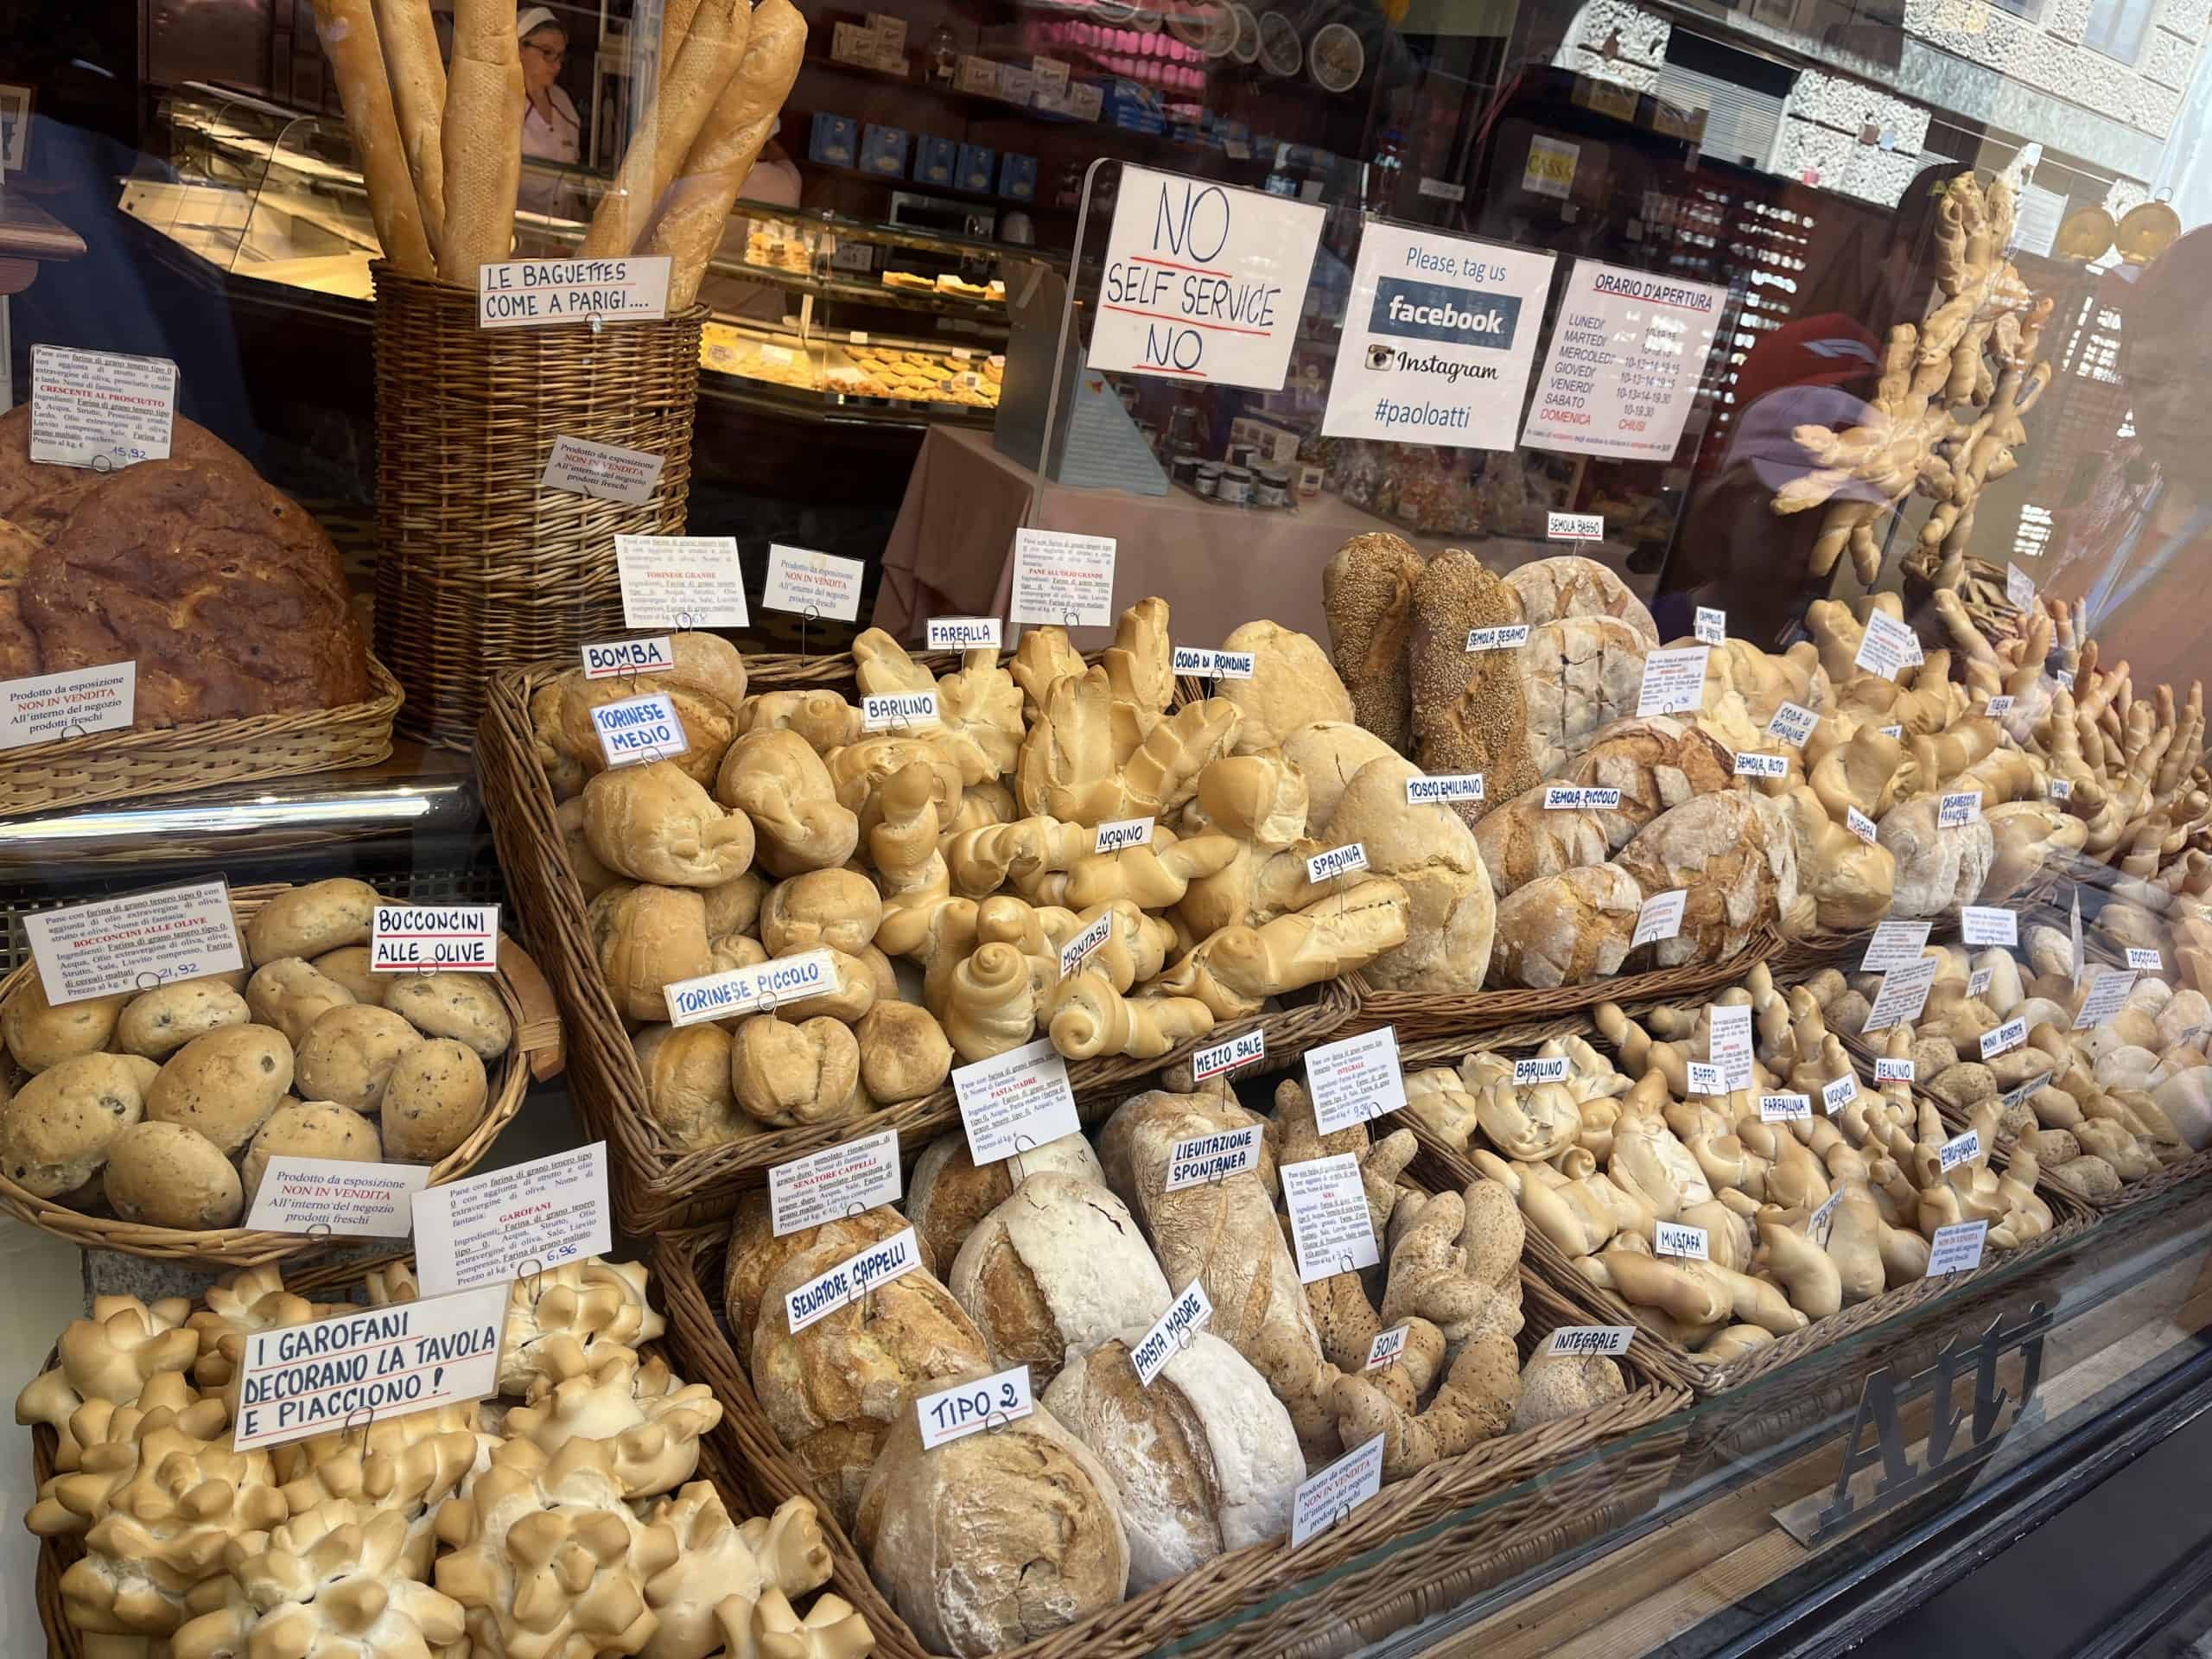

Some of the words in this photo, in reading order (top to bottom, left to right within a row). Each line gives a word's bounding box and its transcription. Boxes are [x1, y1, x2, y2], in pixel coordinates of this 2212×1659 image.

[1154, 181, 1230, 263] NO
[487, 268, 512, 290] LE
[524, 263, 626, 286] BAGUETTES
[1406, 247, 1458, 276] Please,
[1463, 258, 1486, 283] tag
[1490, 265, 1506, 282] us
[1108, 263, 1175, 304] SELF
[1182, 276, 1281, 327] SERVICE
[1595, 274, 1641, 296] ORARIO
[1643, 283, 1712, 308] D'APERTURA
[486, 296, 538, 318] COME
[550, 294, 562, 313] A
[1389, 296, 1503, 334] facebook
[1147, 324, 1202, 369] NO
[1397, 352, 1498, 383] Instagram
[41, 385, 91, 397] CRESCENTE
[110, 393, 165, 408] PROSCIUTTO
[1545, 393, 1585, 409] SABATO
[1375, 398, 1471, 428] #paoloatti
[1541, 409, 1590, 425] DOMENICA
[561, 443, 595, 456] Prodotto
[609, 456, 655, 469] esposizione
[565, 454, 587, 463] NON
[567, 474, 599, 485] prodotti
[601, 480, 627, 491] freschi
[1550, 519, 1575, 531] SEMOLA
[1577, 520, 1599, 534] BASSO
[786, 572, 802, 581] NON
[814, 577, 847, 588] VENDITA
[932, 625, 990, 641] FARFALLA
[1469, 630, 1495, 646] SEMOLA
[1497, 627, 1526, 644] SESAMO
[589, 643, 662, 668] BOMBA
[1176, 651, 1199, 668] CODA
[1214, 654, 1250, 672] RONDINE
[10, 688, 52, 702] Prodotto
[55, 685, 66, 694] da
[69, 677, 124, 691] esposizione
[18, 701, 43, 712] NON
[48, 697, 60, 706] IN
[64, 689, 115, 703] VENDITA
[10, 709, 64, 725] All'interno
[67, 705, 82, 715] del
[85, 699, 122, 712] negozio
[598, 704, 664, 729] TORINESE
[868, 696, 932, 717] BARILINO
[1780, 707, 1802, 725] CODA
[29, 719, 67, 734] prodotti
[72, 712, 102, 723] freschi
[1770, 720, 1805, 741] RONDINE
[612, 726, 671, 750] MEDIO
[1738, 755, 1764, 769] SEMOLA
[1768, 759, 1784, 772] ALTO
[1409, 783, 1438, 797] TOSCO
[1440, 779, 1481, 796] EMILIANO
[1549, 790, 1580, 804] SEMOLA
[1585, 791, 1618, 804] PICCOLO
[1100, 825, 1142, 846] NODINO
[1313, 845, 1361, 875] SPADINA
[379, 909, 485, 932] BOCCONCINI
[73, 929, 142, 949] BOCCONCINI
[145, 922, 173, 936] ALLE
[175, 916, 207, 931] OLIVE
[378, 943, 420, 962] ALLE
[435, 942, 484, 962] OLIVE
[160, 963, 200, 978] 21,92
[677, 981, 752, 1013] TORINESE
[758, 963, 818, 991] PICCOLO
[1982, 1034, 1997, 1050] MINI
[1197, 1046, 1231, 1072] MEZZO
[1237, 1037, 1262, 1057] SALE
[1516, 1060, 1562, 1078] BARILINO
[1693, 1066, 1716, 1083] BAFFO
[990, 1087, 1013, 1099] PASTA
[1014, 1077, 1038, 1091] MADRE
[1826, 1083, 1853, 1105] NODINO
[1764, 1098, 1805, 1112] FARFALLINA
[1176, 1130, 1252, 1161] LIEVITAZIONE
[449, 1187, 470, 1198] Pane
[491, 1174, 513, 1187] farina
[526, 1164, 549, 1177] grano
[551, 1157, 575, 1170] tenero
[578, 1152, 593, 1165] tipo
[793, 1172, 836, 1190] SENATORE
[838, 1157, 877, 1176] CAPPELLI
[1174, 1151, 1246, 1181] SPONTANEA
[276, 1171, 324, 1184] Prodotto
[327, 1175, 340, 1185] da
[344, 1178, 405, 1189] esposizione
[282, 1185, 311, 1196] NON
[315, 1186, 329, 1197] IN
[334, 1188, 391, 1200] VENDITA
[269, 1198, 330, 1210] All'interno
[333, 1202, 349, 1211] del
[353, 1203, 395, 1214] negozio
[451, 1198, 501, 1217] extravergine
[499, 1202, 552, 1223] GAROFANI
[285, 1212, 329, 1224] prodotti
[333, 1214, 369, 1224] freschi
[546, 1243, 577, 1262] 6,96
[791, 1273, 849, 1319] SENATORE
[852, 1243, 906, 1285] CAPPELLI
[258, 1339, 264, 1365] I
[279, 1311, 409, 1362] GAROFANI
[1135, 1332, 1168, 1376] PASTA
[1166, 1293, 1201, 1339] MADRE
[1374, 1333, 1400, 1358] SOIA
[1555, 1332, 1619, 1349] INTEGRALE
[245, 1354, 368, 1405] DECORANO
[377, 1346, 404, 1376] LA
[416, 1325, 495, 1364] TAVOLA
[245, 1409, 259, 1437] E
[279, 1373, 422, 1427] PIACCIONO
[931, 1391, 991, 1428] TIPO
[1000, 1382, 1019, 1408] 2
[1299, 1480, 1328, 1502] Prodotto
[1338, 1445, 1378, 1474] esposizione
[1304, 1491, 1323, 1510] NON
[1322, 1484, 1333, 1498] IN
[1333, 1460, 1370, 1490] VENDITA
